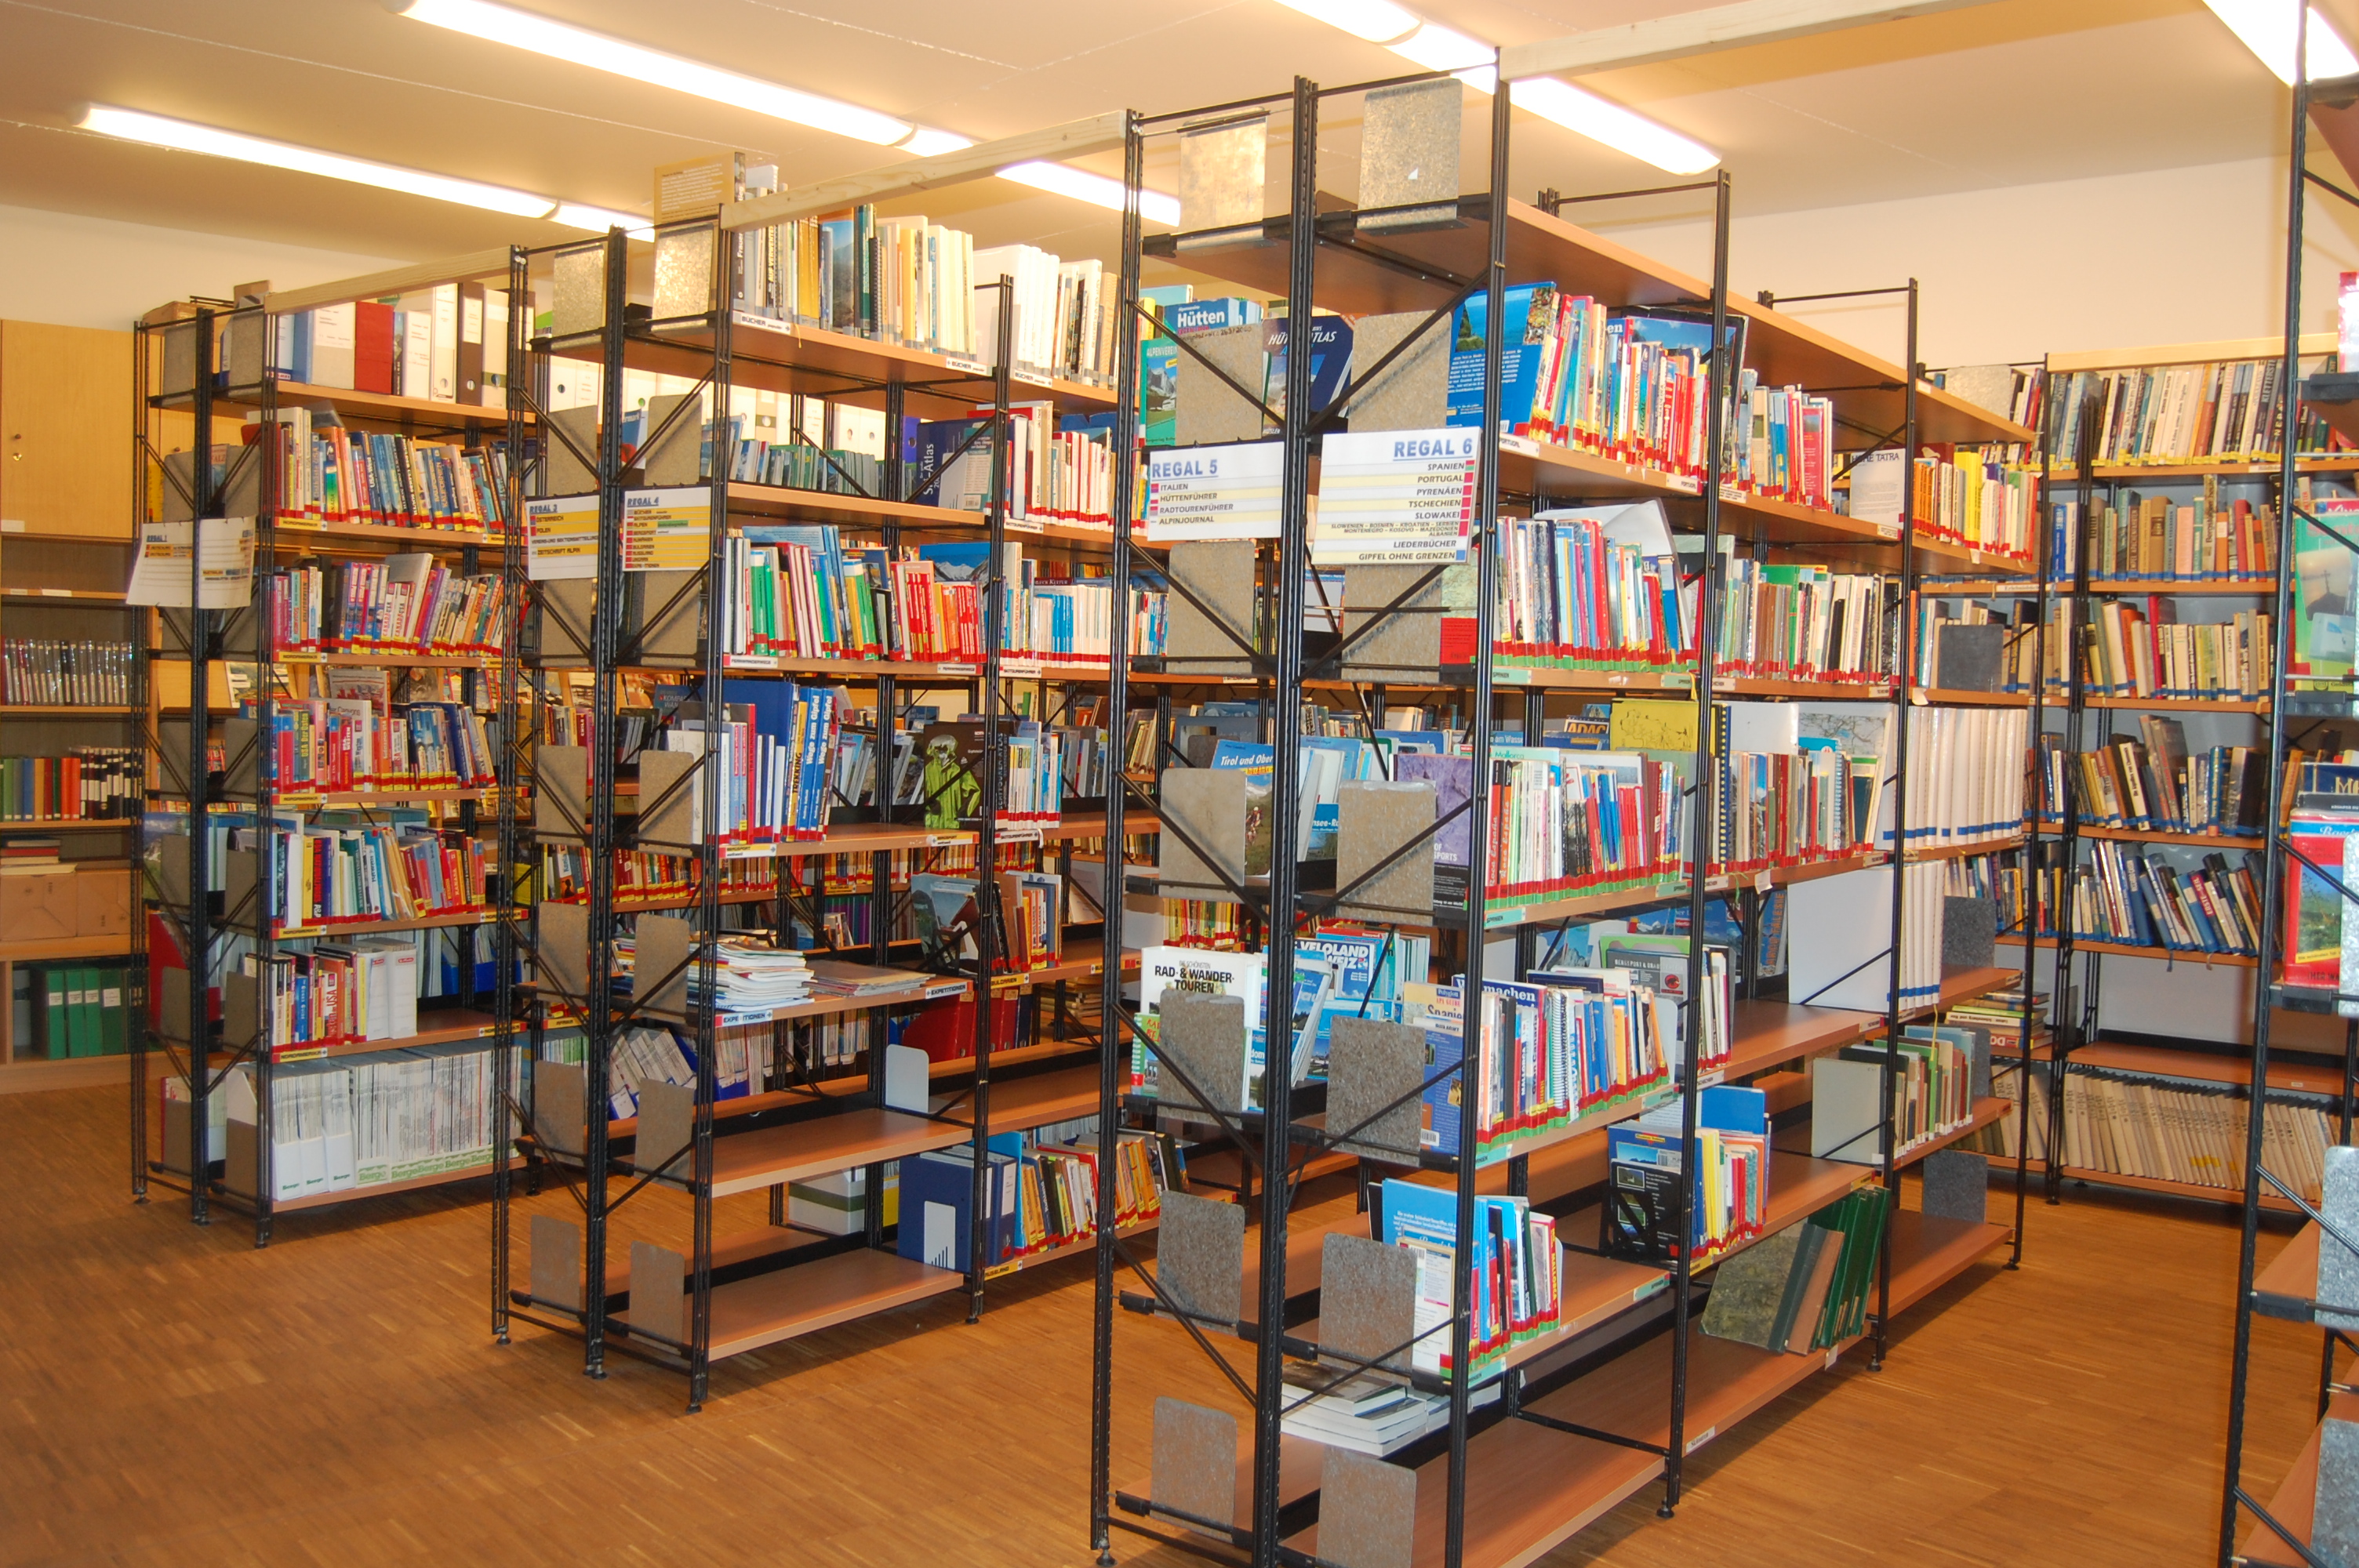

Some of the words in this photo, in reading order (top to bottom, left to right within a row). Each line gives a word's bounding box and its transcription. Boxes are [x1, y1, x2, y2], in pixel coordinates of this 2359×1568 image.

[741, 315, 766, 326] BÜCHER
[1178, 310, 1225, 328] Hütten
[951, 361, 972, 370] BÜCHER
[1015, 372, 1034, 381] BÜCHER
[1394, 440, 1455, 457] REGAL
[1463, 438, 1473, 454] 6
[1876, 452, 1899, 463] TATRA
[923, 443, 934, 495] S-Atlas
[1152, 460, 1202, 477] REGAL
[1209, 459, 1218, 474] 5
[1161, 492, 1217, 502] HÜTTENFÜHRER
[1416, 487, 1462, 495] PYRENÄEN
[627, 497, 652, 506] REGAL
[654, 496, 660, 505] 4
[1408, 499, 1461, 508] TSCHECHIEN
[530, 505, 551, 514] REGAL
[1160, 503, 1234, 514] RADTOURENFÜHRER
[1159, 516, 1214, 524] ALPINJOURNAL
[806, 741, 816, 765] Wege
[811, 695, 820, 720] Gipfel
[818, 741, 827, 765] Wege
[824, 695, 833, 720] Gipfel
[1568, 722, 1607, 734] ADAC
[1220, 755, 1238, 767] Tirol
[1240, 754, 1253, 765] und
[1256, 753, 1273, 764] Ober
[1495, 750, 1525, 759] Mallorca
[792, 752, 803, 794] TREKKING
[1434, 843, 1442, 851] OF
[2201, 893, 2214, 916] ERSTE
[1300, 942, 1369, 957] VELOLAND
[1180, 967, 1187, 978] &
[1189, 968, 1234, 983] WANDER-
[1174, 979, 1215, 993] TOUREN
[326, 989, 338, 1007] USA
[1483, 985, 1536, 1002] machen
[1427, 1004, 1463, 1019] Spanie
[1550, 1252, 1559, 1300] MALLORCA
[1468, 1372, 1482, 1383] PANIEN
